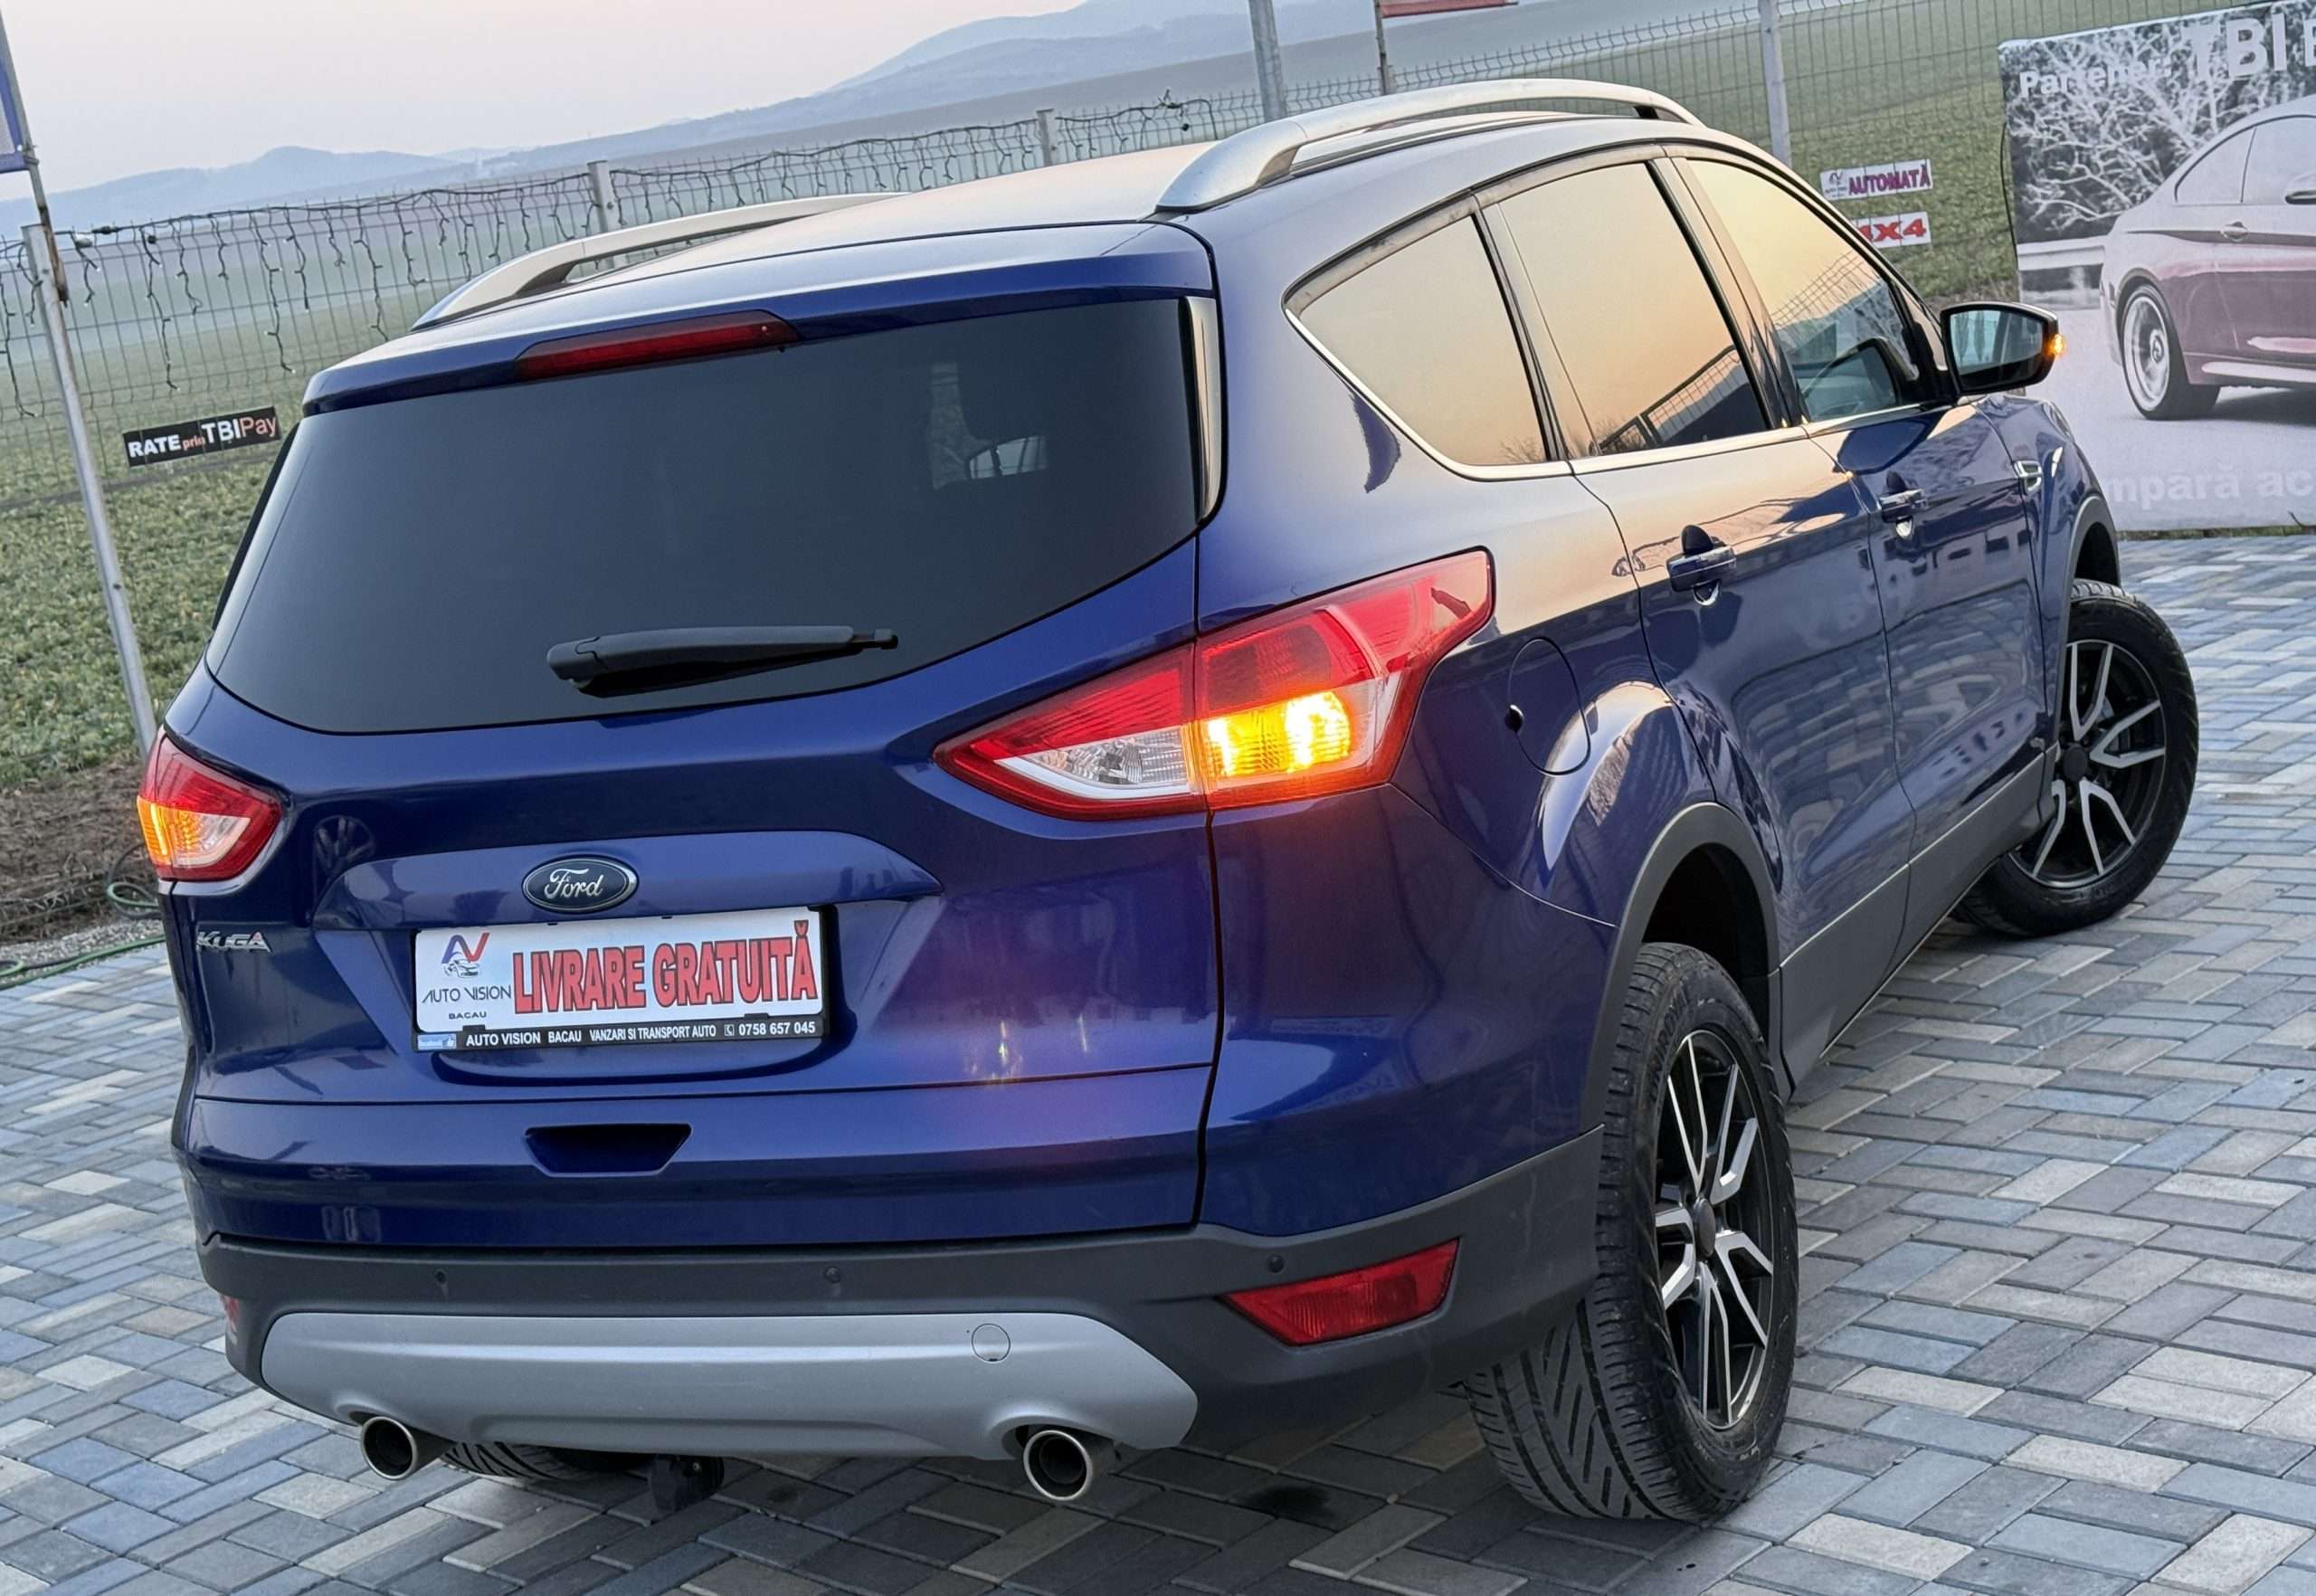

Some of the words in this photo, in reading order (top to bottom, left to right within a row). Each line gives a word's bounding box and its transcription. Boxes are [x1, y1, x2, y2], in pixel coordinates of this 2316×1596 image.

[2181, 13, 2288, 80] TBI
[1848, 164, 1932, 195] AUTOMATĂ
[128, 434, 182, 458] RATE
[201, 416, 277, 443] TBIPay
[544, 867, 604, 899] Ford
[512, 945, 647, 1014] LIVRARE
[652, 919, 819, 1007] GRATUITĂ
[422, 987, 461, 1003] AUTO
[464, 984, 511, 1001] VISION
[449, 1011, 487, 1021] BACAU
[466, 1033, 498, 1047] AUTO
[501, 1031, 541, 1046] VISION
[547, 1030, 582, 1043] BACAU
[589, 1028, 626, 1041] VANZARI
[628, 1027, 636, 1040] SI
[638, 1025, 691, 1040] TRANSPORT
[692, 1024, 717, 1038] AUTO
[738, 1022, 766, 1036] 0758
[770, 1021, 790, 1034] 657
[794, 1021, 816, 1034] 045
